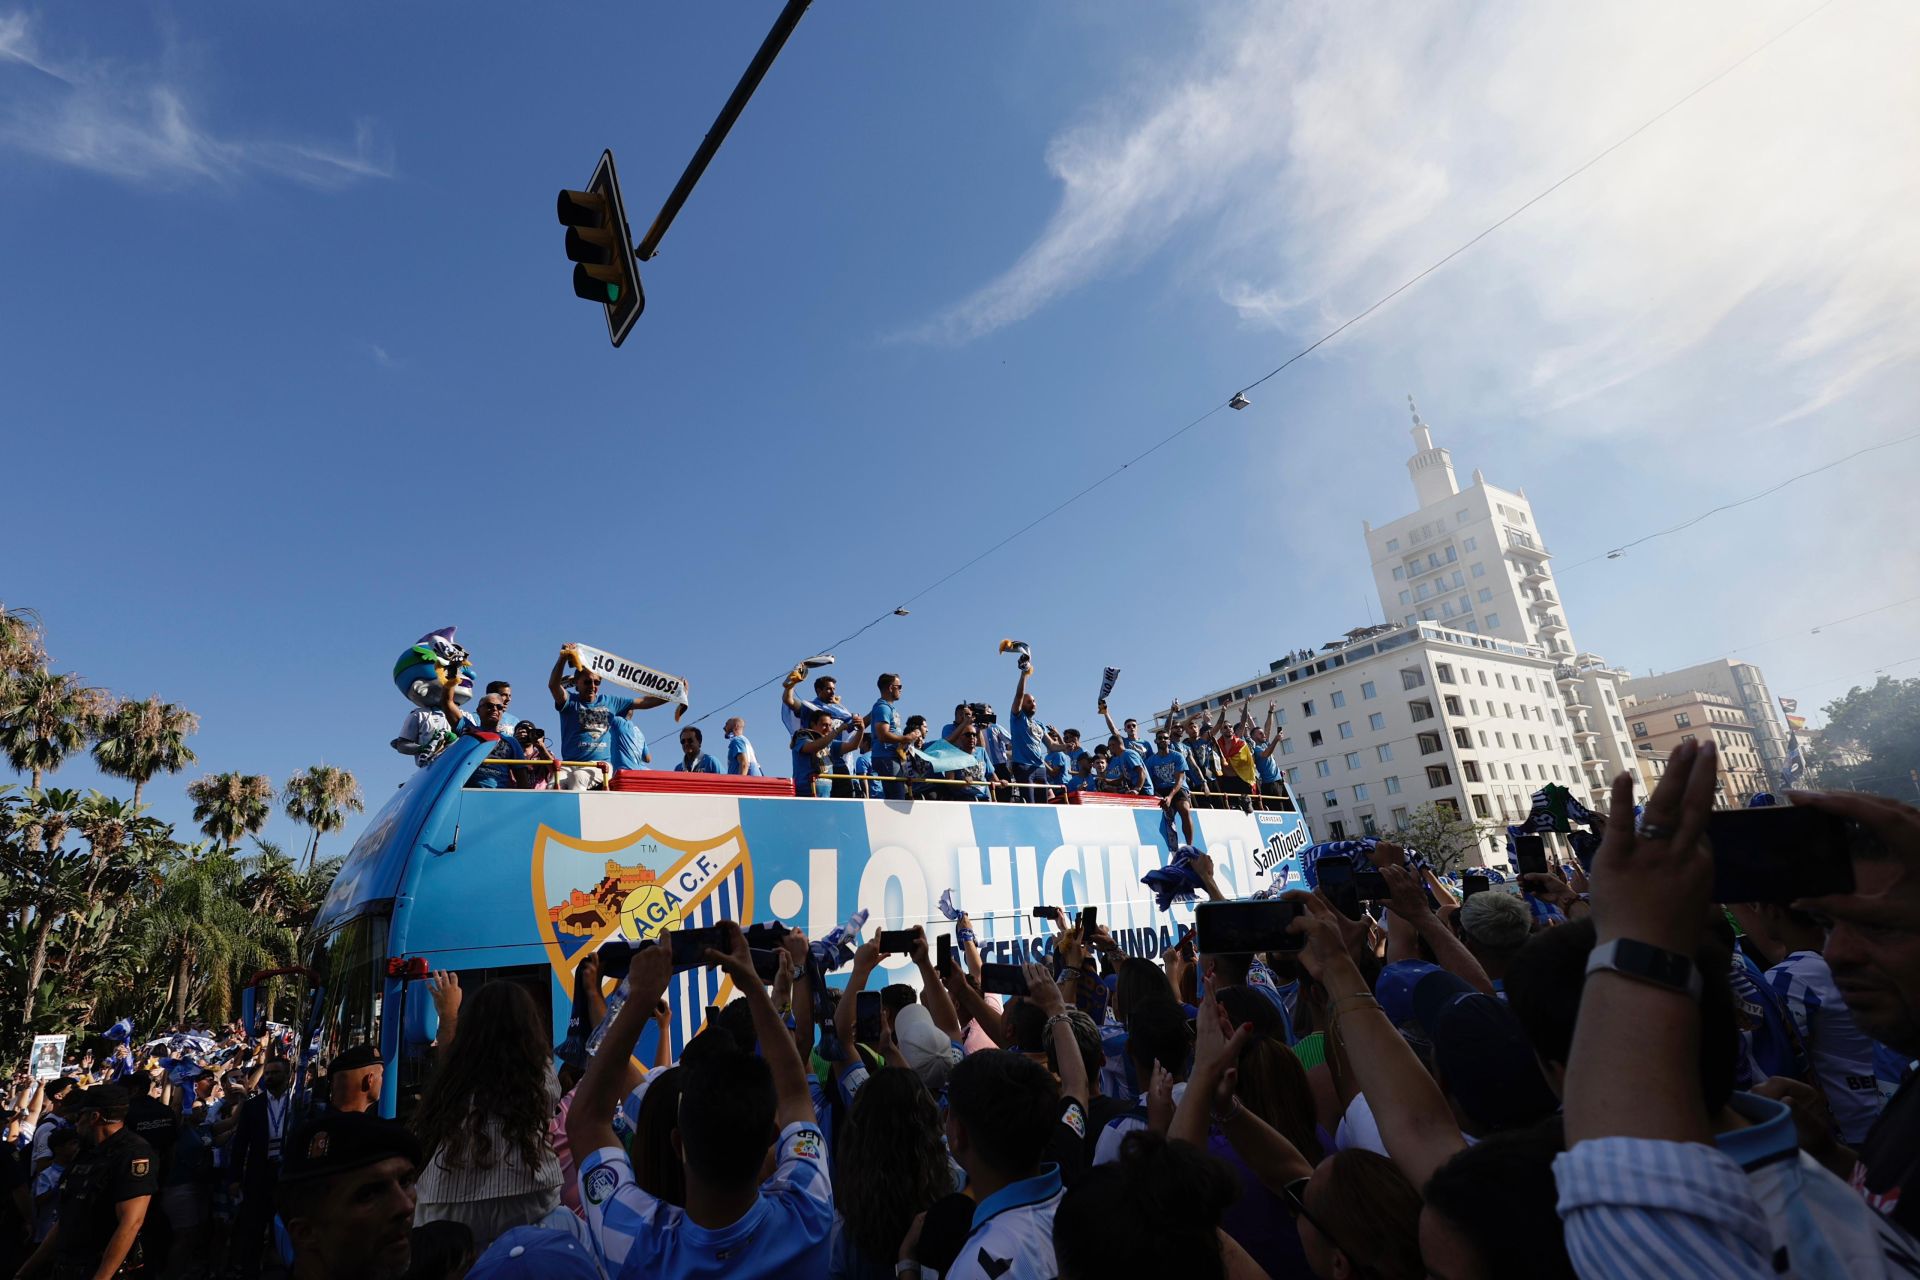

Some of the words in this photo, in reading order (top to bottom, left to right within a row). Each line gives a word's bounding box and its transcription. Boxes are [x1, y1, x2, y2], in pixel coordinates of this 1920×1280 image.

[592, 655, 615, 672] ¡LO
[617, 662, 680, 695] HICIMOS!
[641, 844, 658, 853] TM
[679, 854, 719, 893] C.F.
[955, 839, 1247, 945] HICIMS!
